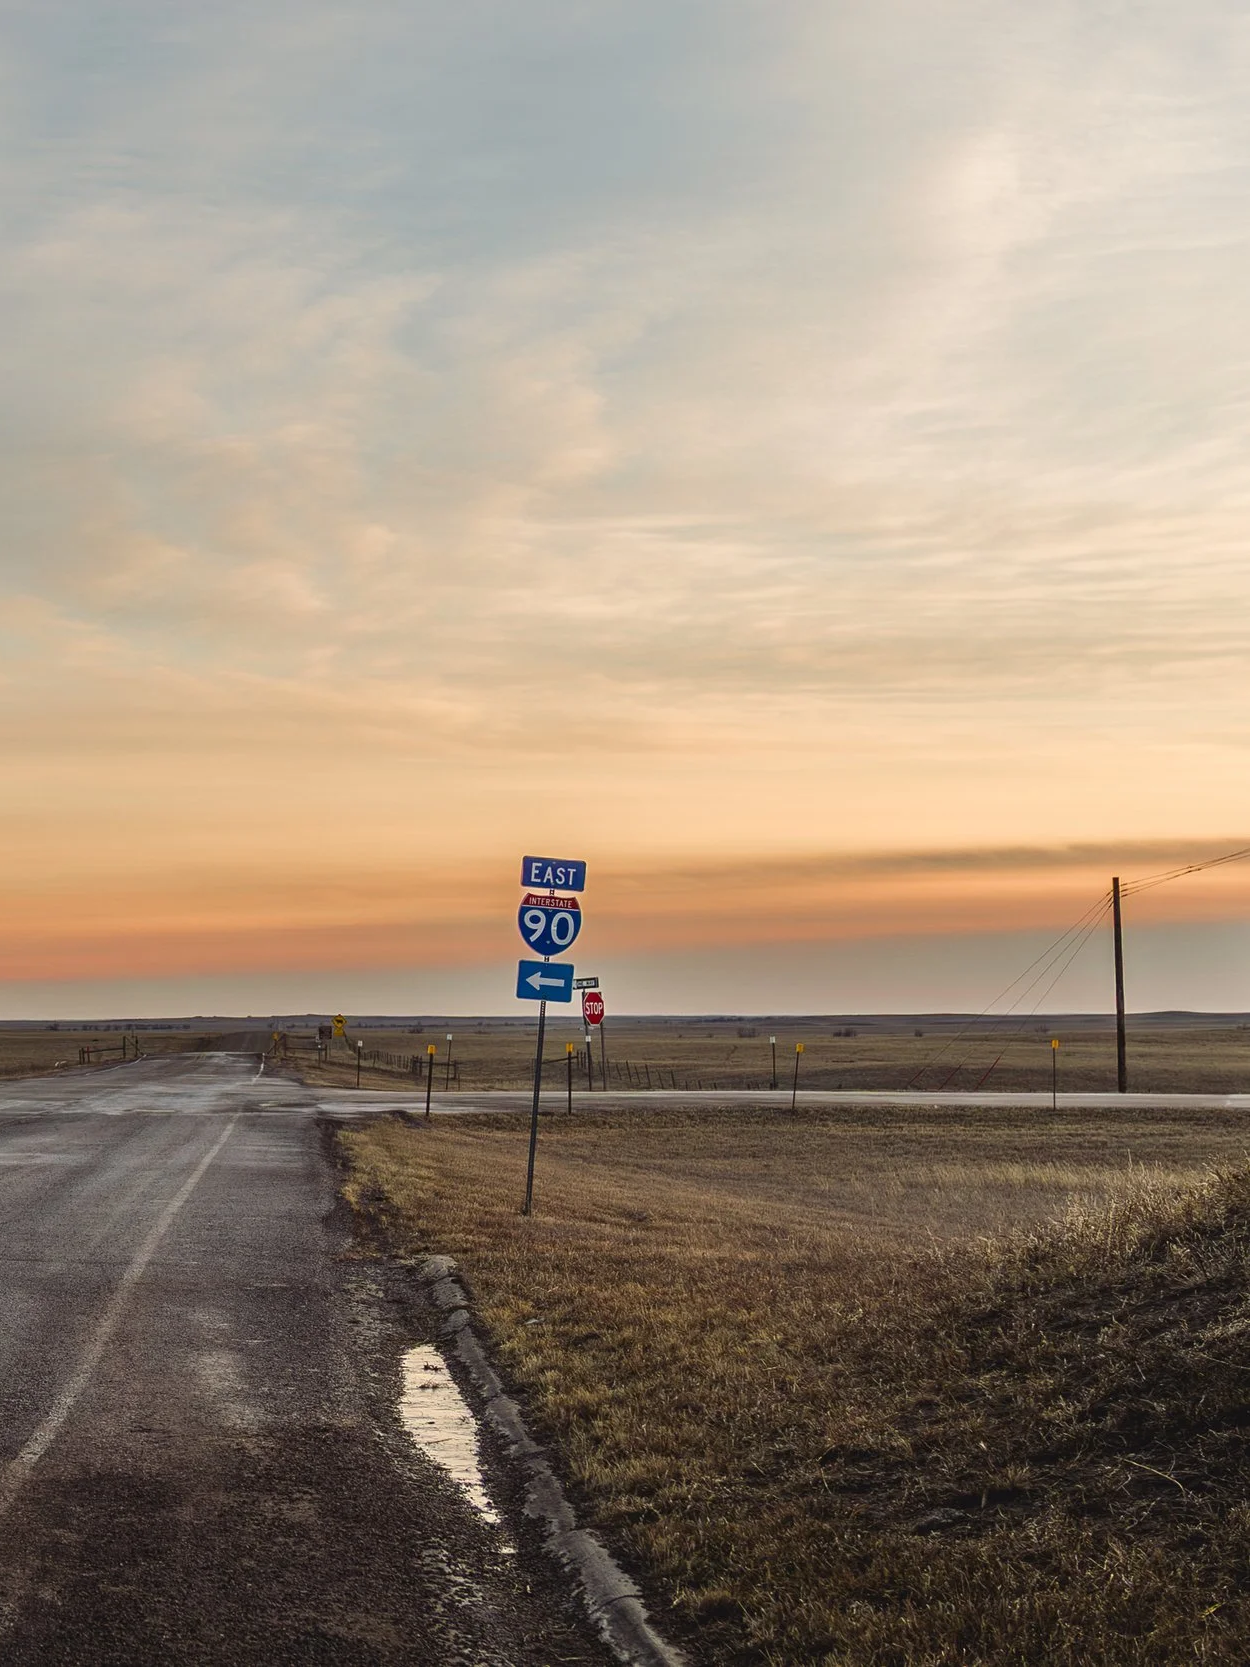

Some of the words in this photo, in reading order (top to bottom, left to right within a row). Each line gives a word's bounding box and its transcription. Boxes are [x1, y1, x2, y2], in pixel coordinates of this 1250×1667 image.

[530, 862, 577, 885] EAST
[529, 897, 573, 908] INTERSTATE
[524, 909, 575, 946] 90
[585, 1002, 603, 1015] STOP
